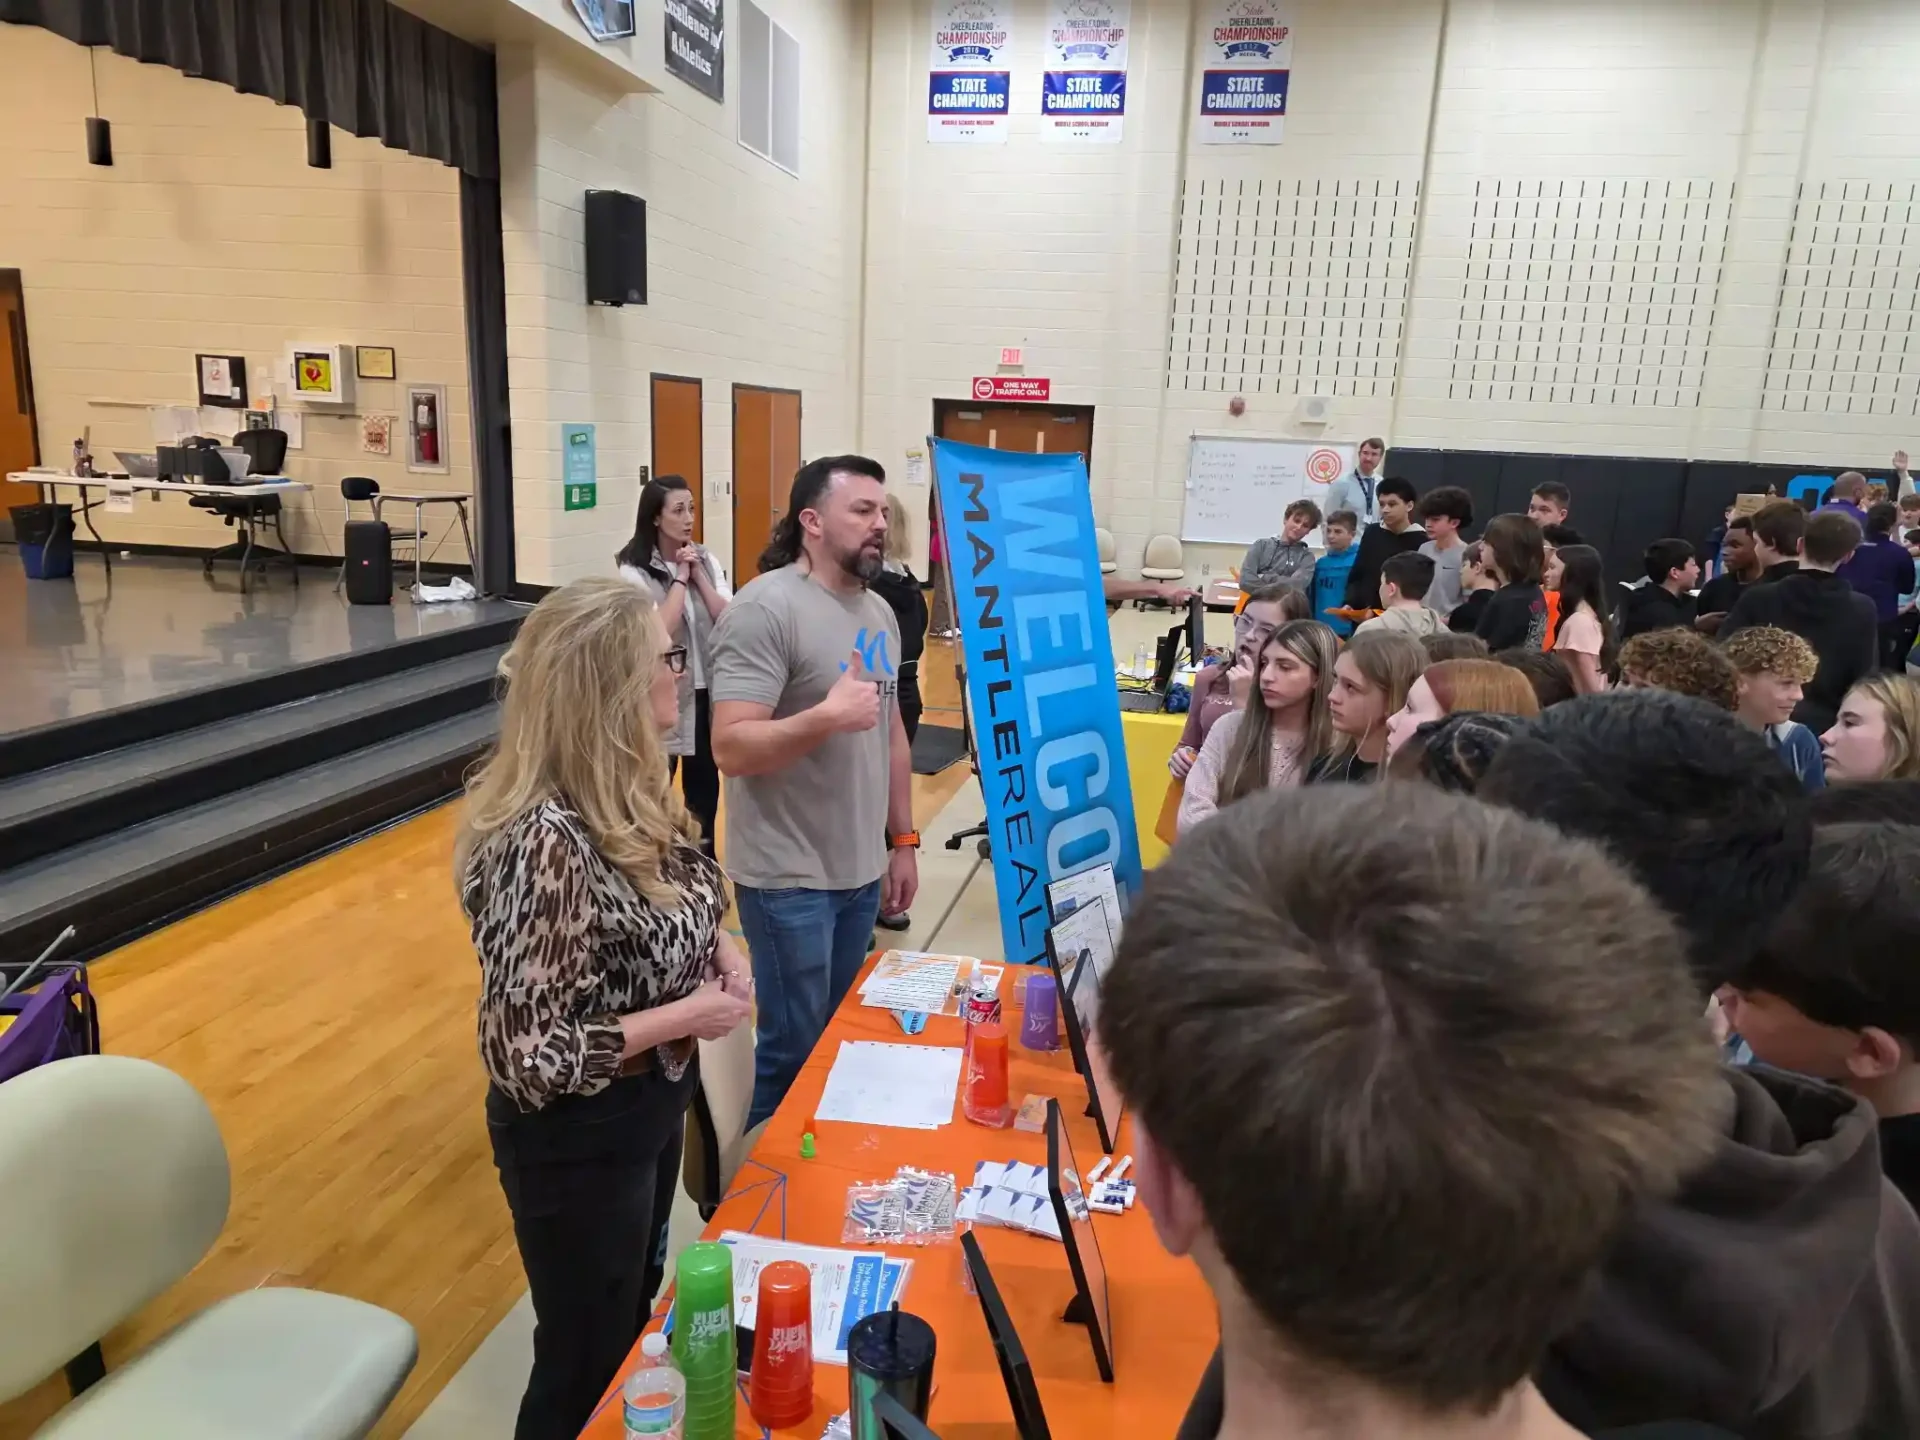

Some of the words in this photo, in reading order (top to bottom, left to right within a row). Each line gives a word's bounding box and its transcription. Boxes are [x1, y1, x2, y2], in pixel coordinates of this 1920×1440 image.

[950, 22, 994, 31] CHEERLEADING
[1229, 17, 1275, 27] CHEERLEADING
[936, 31, 1007, 45] CHAMPIONSHIP
[1052, 28, 1125, 43] CHAMPIONSHIP
[1213, 27, 1289, 41] CHAMPIONSHIP
[671, 30, 711, 77] Athletics
[951, 77, 987, 93] STATE
[1066, 77, 1102, 93] STATE
[1227, 76, 1265, 93] STATE
[933, 93, 1005, 109] CHAMPIONS
[1047, 93, 1120, 109] CHAMPIONS
[1206, 93, 1282, 109] CHAMPIONS
[995, 388, 1025, 396] TRAFFIC
[1003, 381, 1019, 389] ONE
[997, 470, 1125, 905] WELCO
[914, 1179, 940, 1213] MANTLE
[879, 1197, 893, 1231] MANTLE
[865, 1262, 874, 1275] The
[852, 1262, 865, 1296] Difference
[861, 1275, 872, 1298] Mantle
